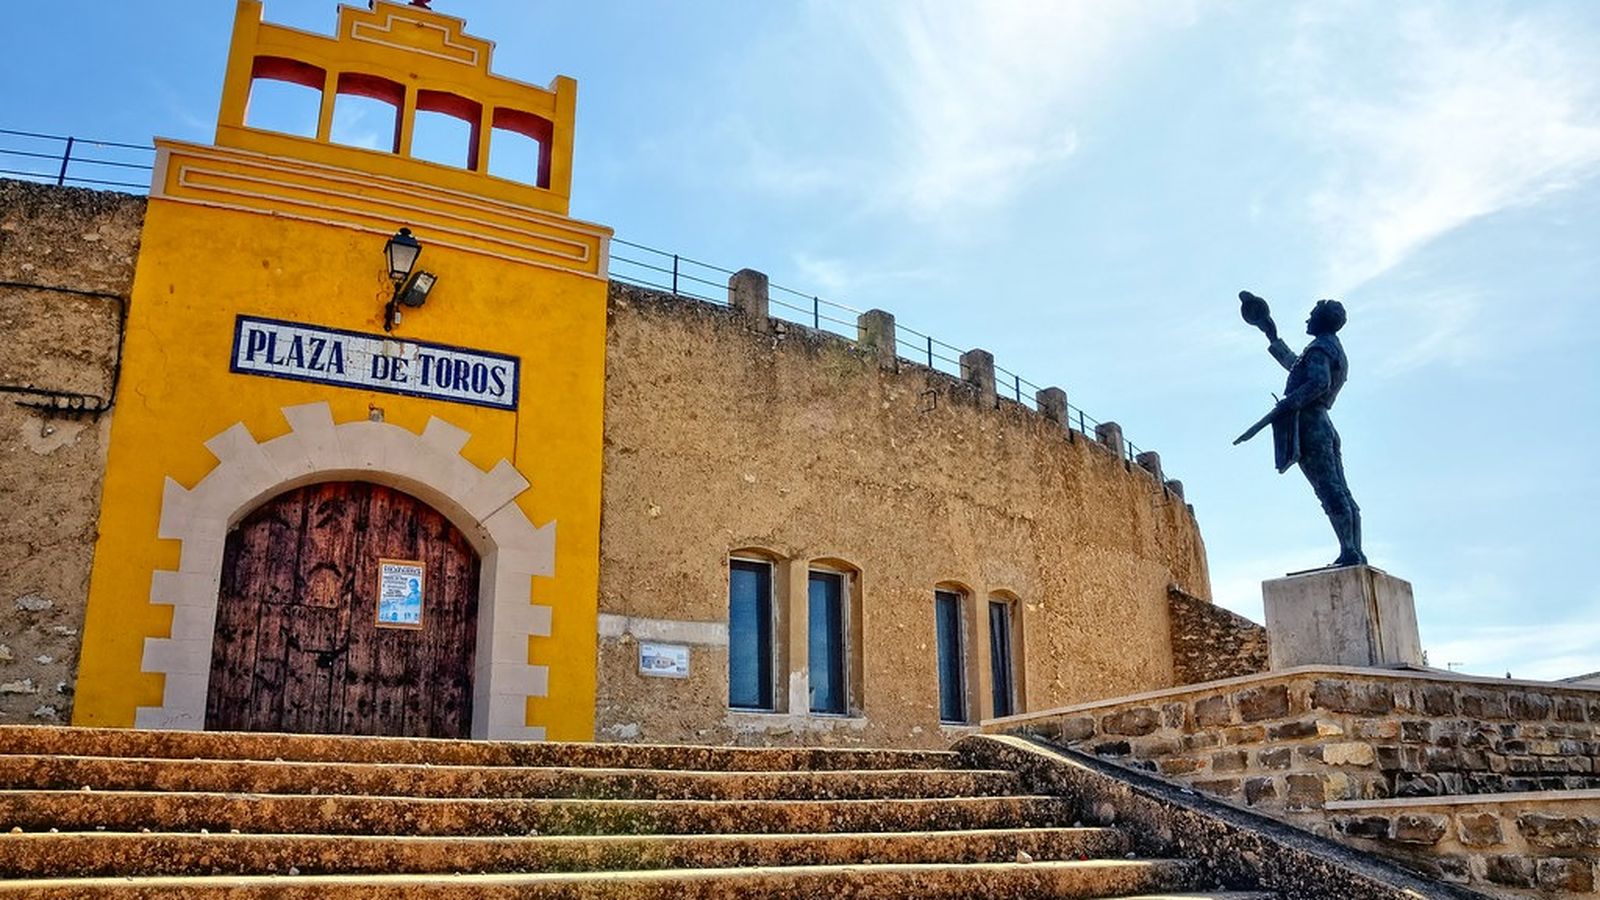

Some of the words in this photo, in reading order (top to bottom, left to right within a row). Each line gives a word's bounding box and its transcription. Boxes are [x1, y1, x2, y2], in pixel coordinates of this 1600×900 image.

[246, 329, 345, 374] PLAZA
[371, 354, 409, 382] DE
[418, 354, 507, 397] TOROS
